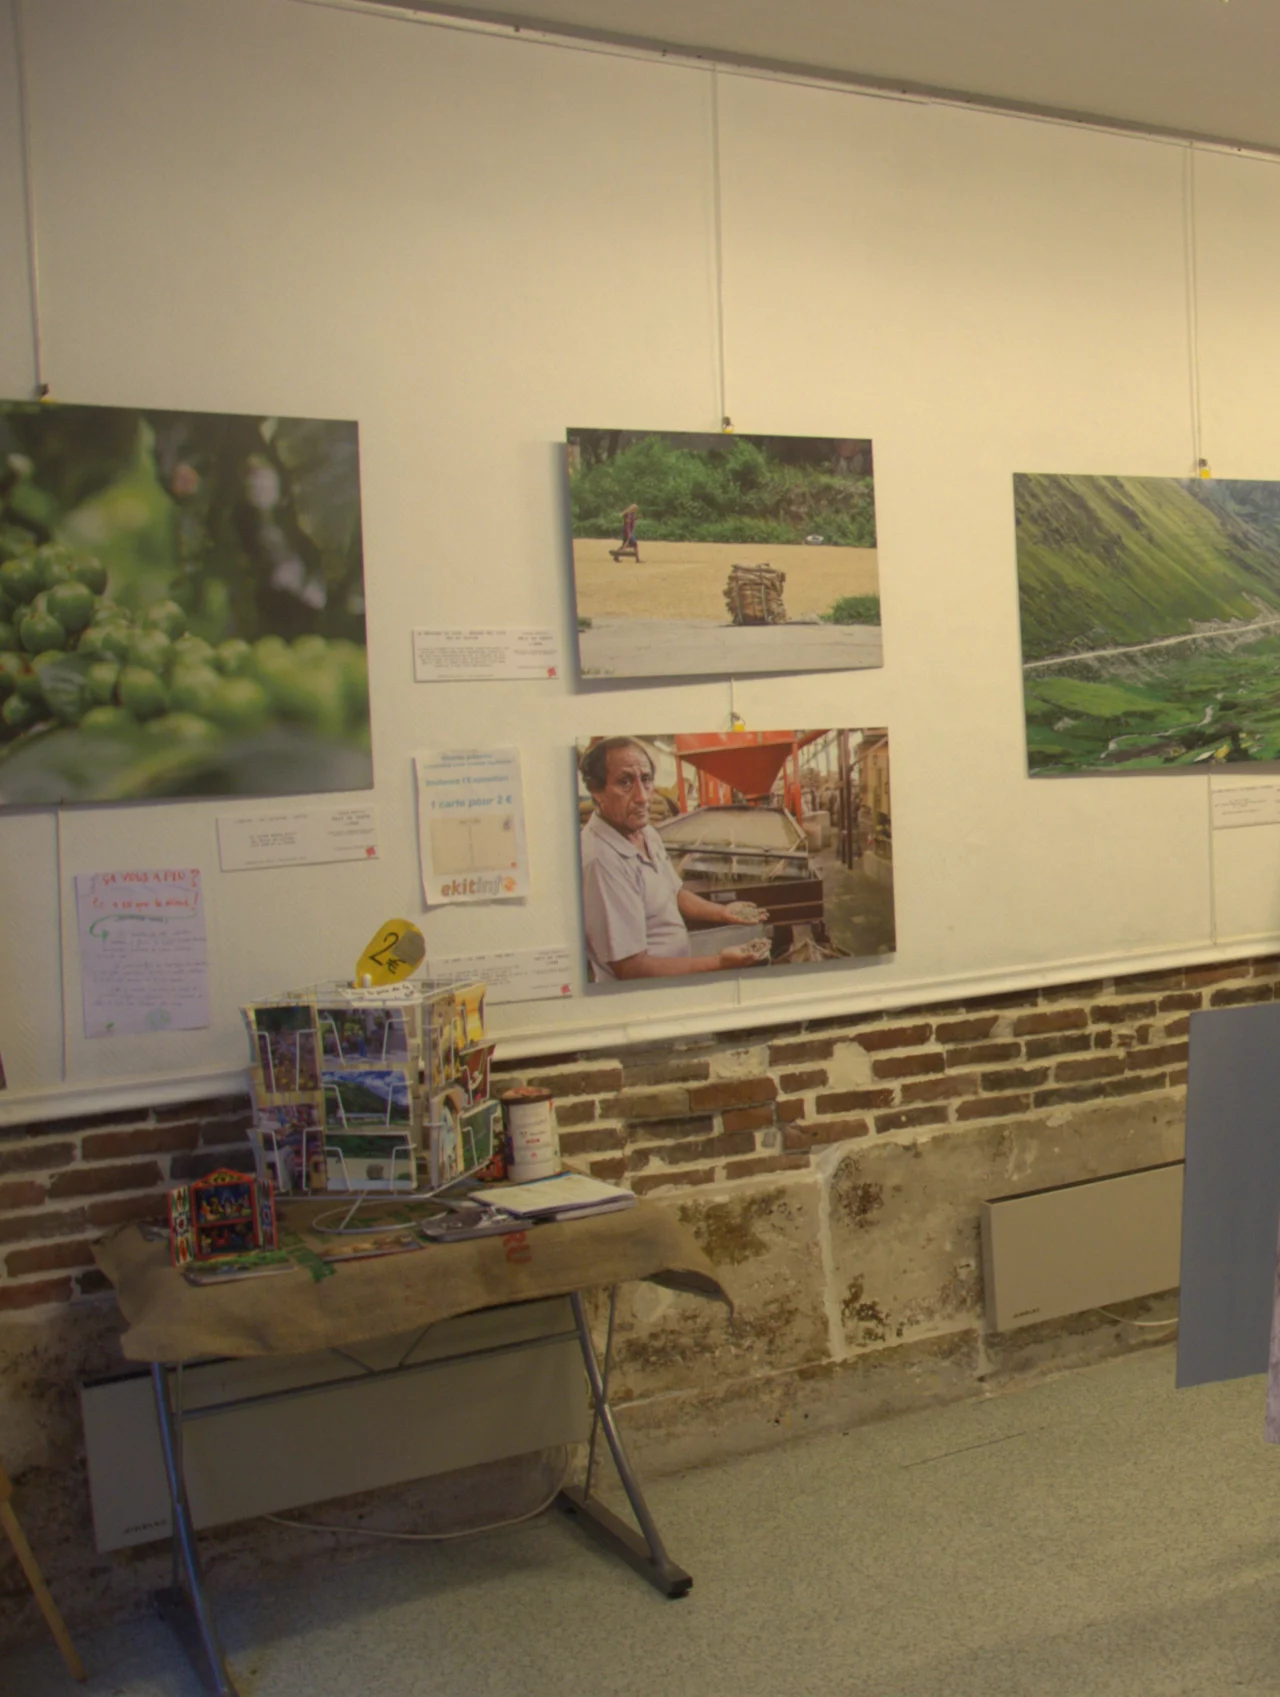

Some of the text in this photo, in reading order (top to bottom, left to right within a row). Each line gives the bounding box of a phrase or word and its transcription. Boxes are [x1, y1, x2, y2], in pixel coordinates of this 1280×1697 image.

[430, 799, 436, 810] 1
[438, 797, 466, 809] carte
[467, 796, 496, 809] pour
[121, 871, 149, 884] VOUS
[152, 871, 161, 884] A
[368, 931, 408, 975] 2 €
